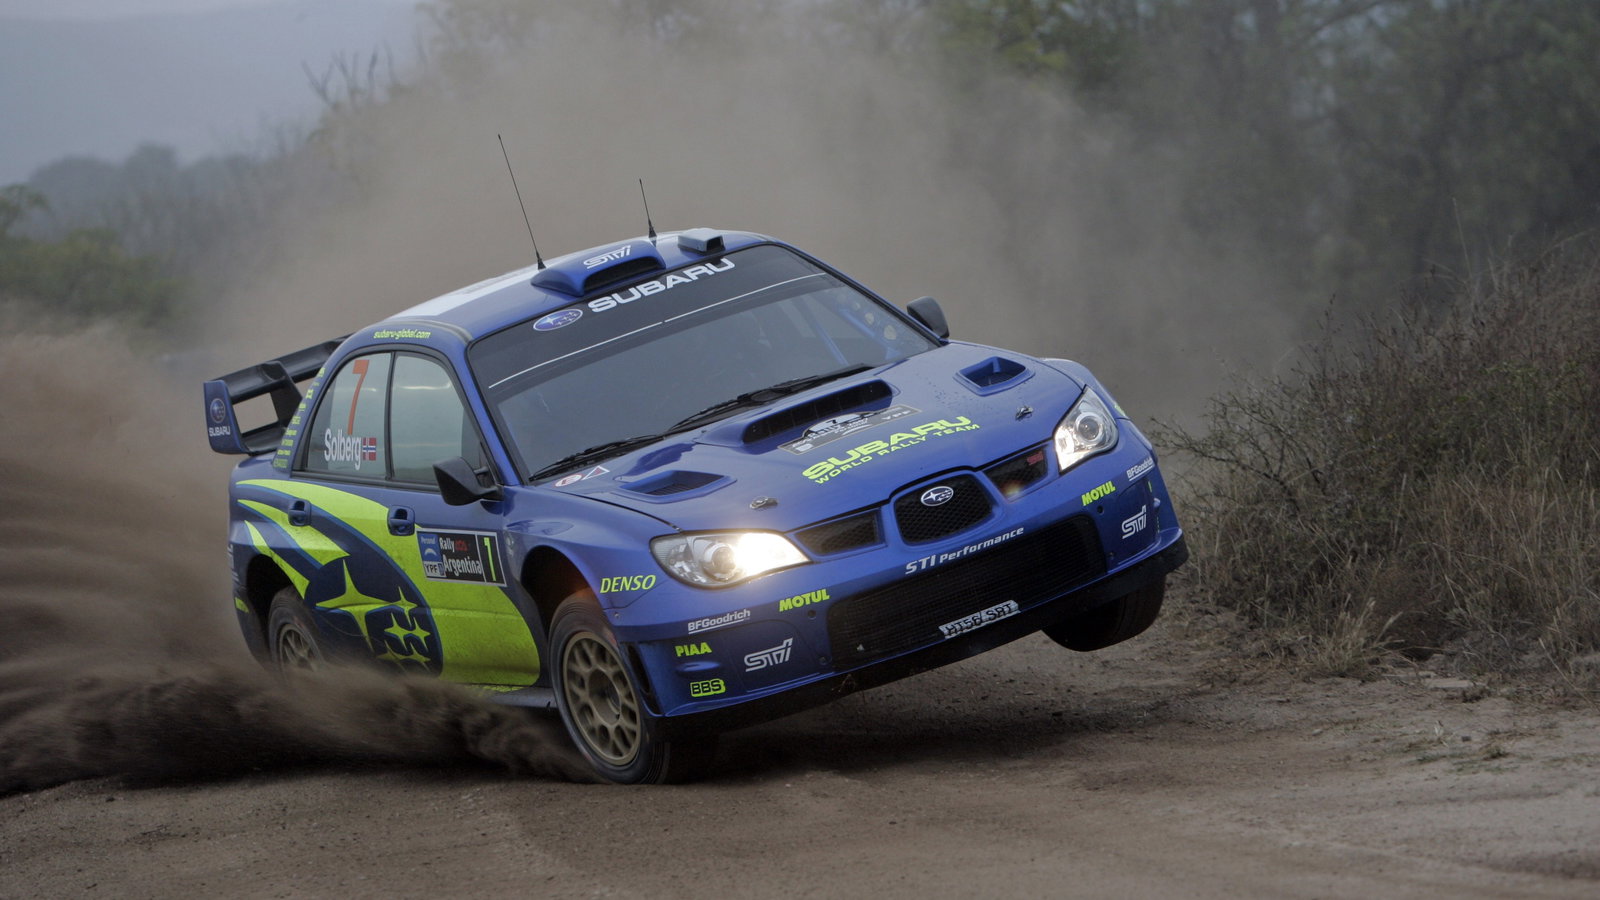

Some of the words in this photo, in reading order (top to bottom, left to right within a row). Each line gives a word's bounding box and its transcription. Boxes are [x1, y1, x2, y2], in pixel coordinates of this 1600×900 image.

[587, 258, 736, 313] SUBARU
[347, 359, 370, 436] 7
[208, 425, 231, 437] SUBARU
[324, 428, 361, 470] Solberg
[802, 416, 972, 480] SUBARU
[815, 455, 873, 484] WORLD
[878, 435, 928, 456] RALLY
[932, 423, 980, 437] TEAM
[1081, 481, 1117, 507] MOTUL
[439, 536, 455, 553] Rally
[905, 554, 936, 575] STI
[939, 527, 1025, 564] Performance
[442, 554, 483, 577] Argentina
[484, 536, 497, 582] 1
[600, 574, 657, 594] DENSO
[779, 588, 831, 612] MOTUL
[688, 608, 751, 633] BFGoodrich
[675, 642, 713, 657] PIAA
[691, 679, 722, 695] BBS
